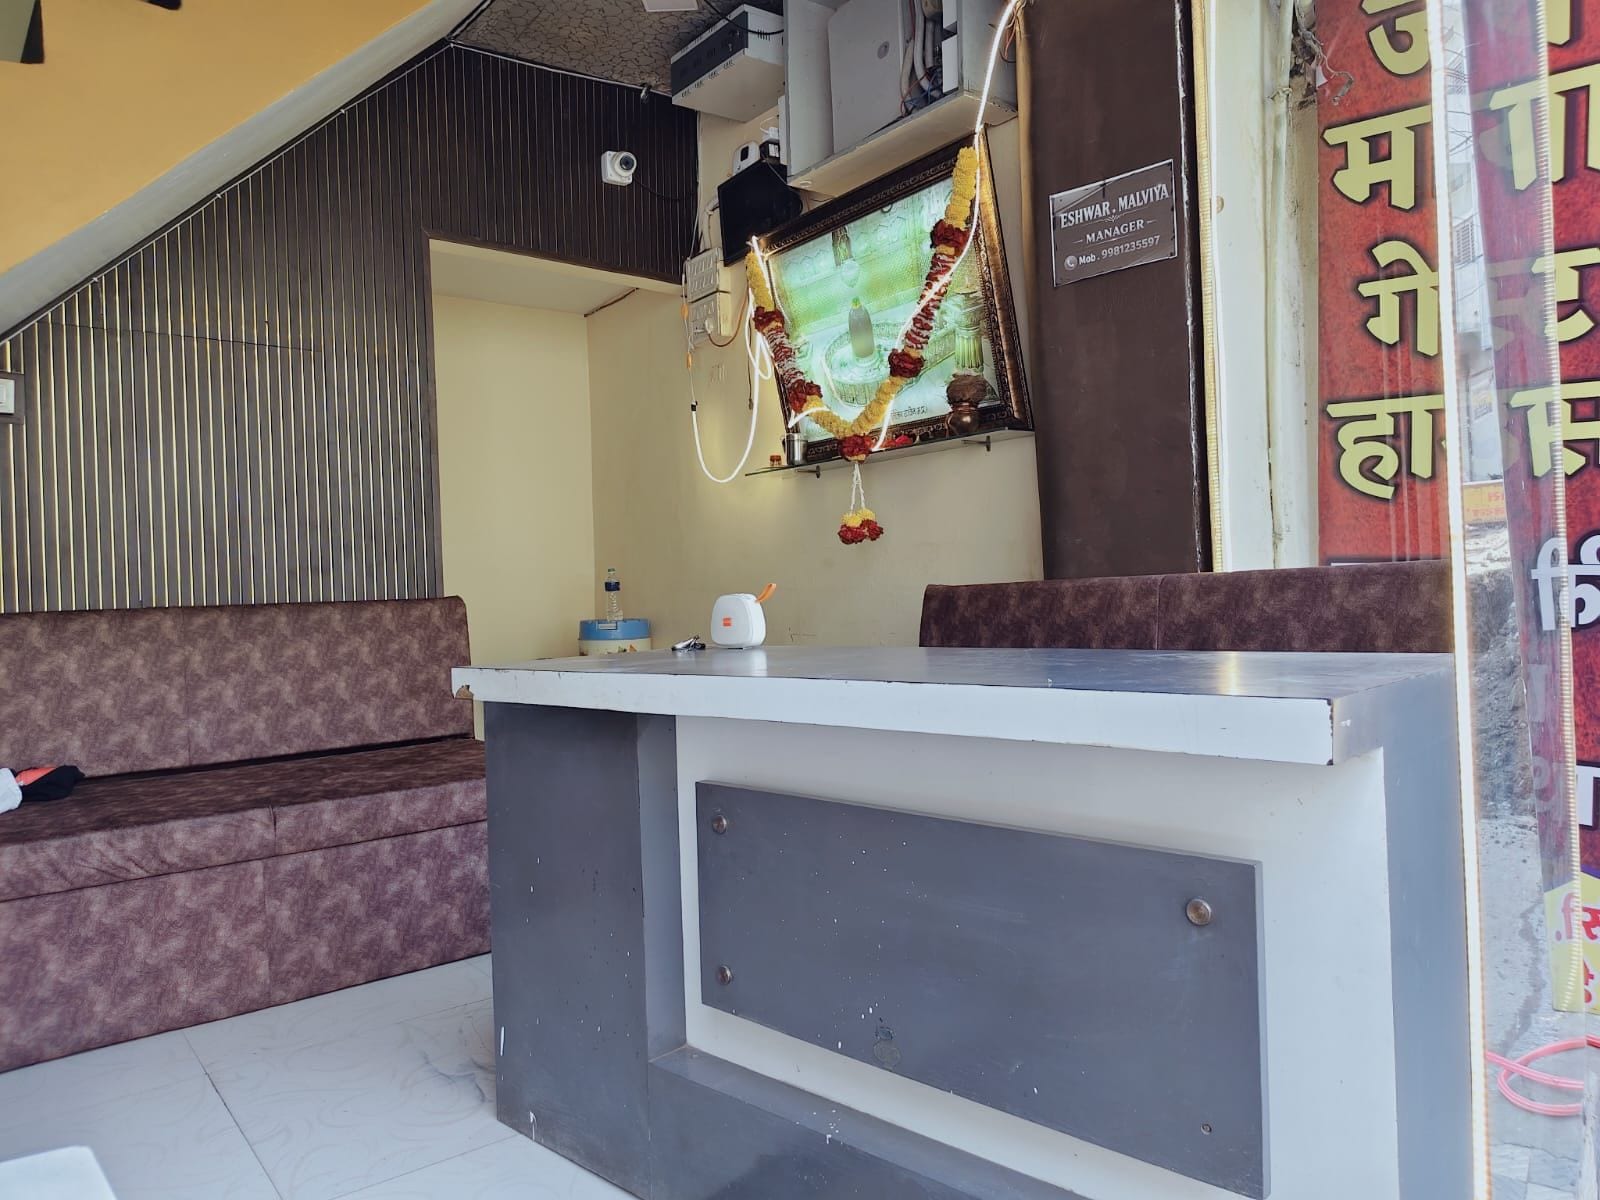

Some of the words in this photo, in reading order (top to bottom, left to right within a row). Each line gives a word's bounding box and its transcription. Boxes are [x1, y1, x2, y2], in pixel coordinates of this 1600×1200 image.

[1118, 183, 1169, 212] MALVIYA
[1086, 219, 1144, 244] MANAGER
[1101, 234, 1160, 259] 9981235597
